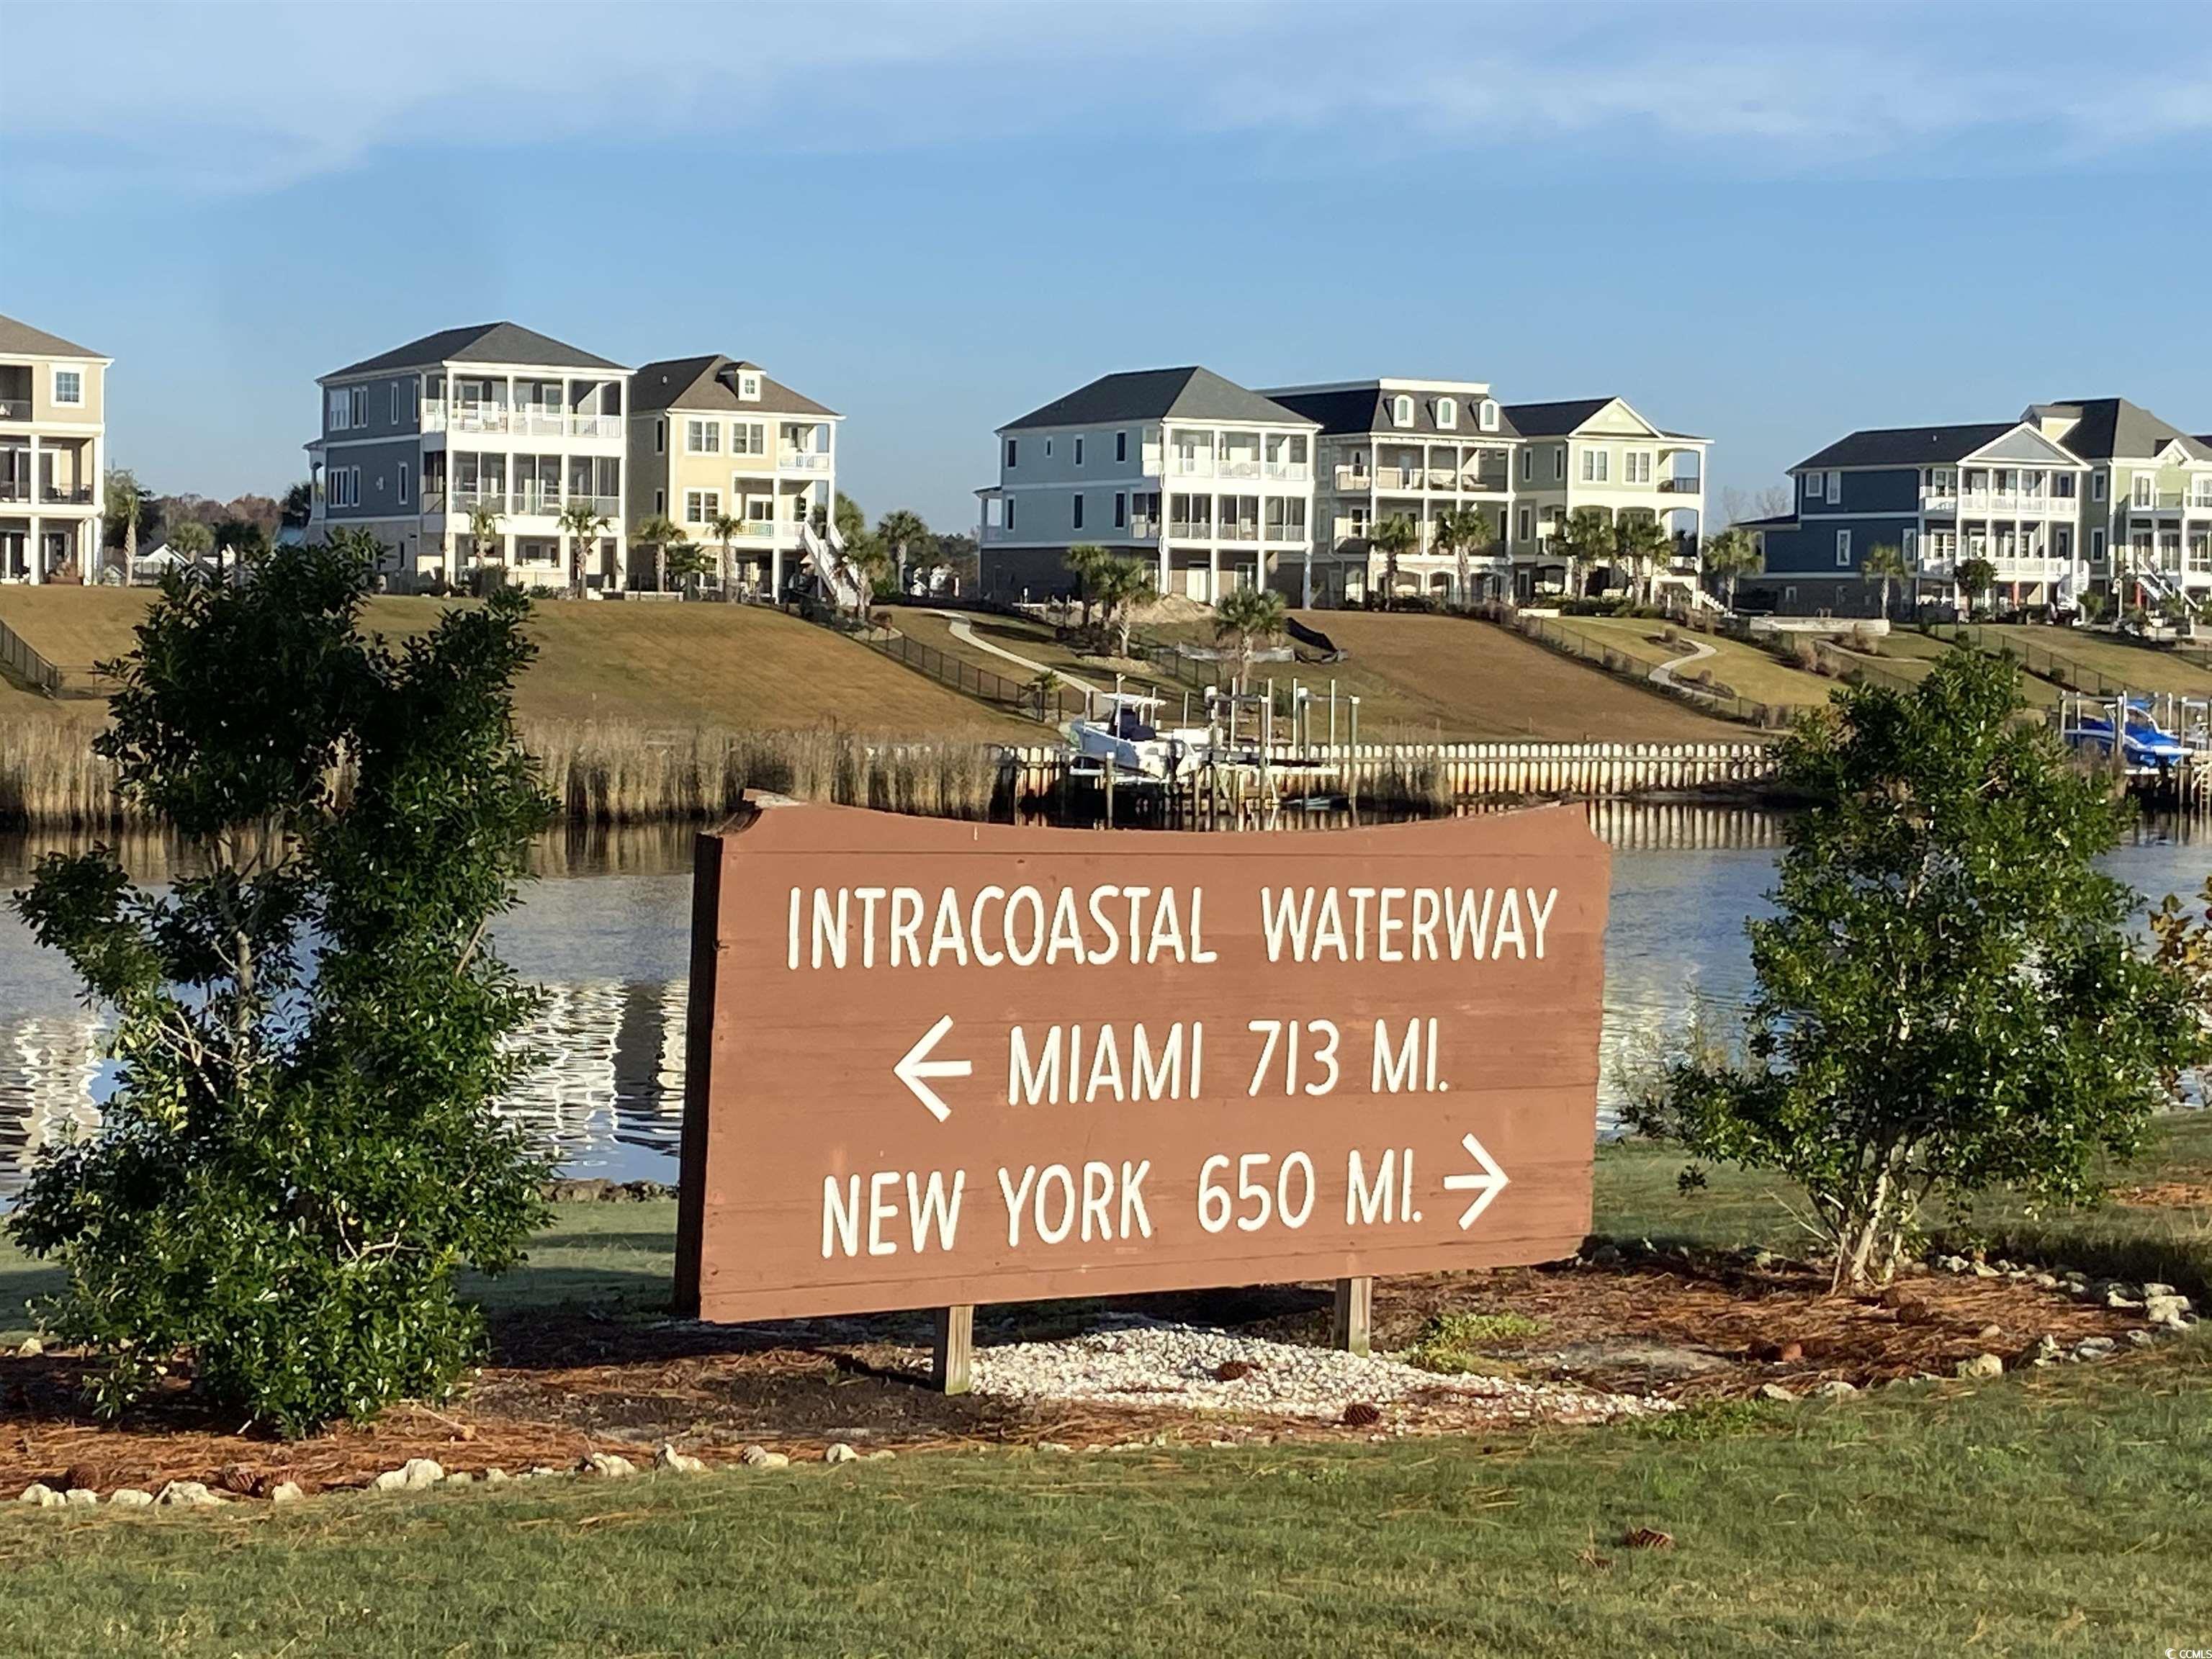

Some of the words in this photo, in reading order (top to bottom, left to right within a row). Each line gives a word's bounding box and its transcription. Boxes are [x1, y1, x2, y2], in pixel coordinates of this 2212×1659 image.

[788, 885, 1218, 970] INTRACOASTAL
[1261, 886, 1558, 963] WATERWAY
[1008, 1021, 1202, 1106] MIAMI
[1249, 1019, 1340, 1097] 713
[1372, 1017, 1449, 1093] MI.
[822, 1169, 966, 1259] NEW
[997, 1160, 1152, 1247] YORK
[1198, 1151, 1316, 1233] 650
[1346, 1148, 1423, 1226] MI.
